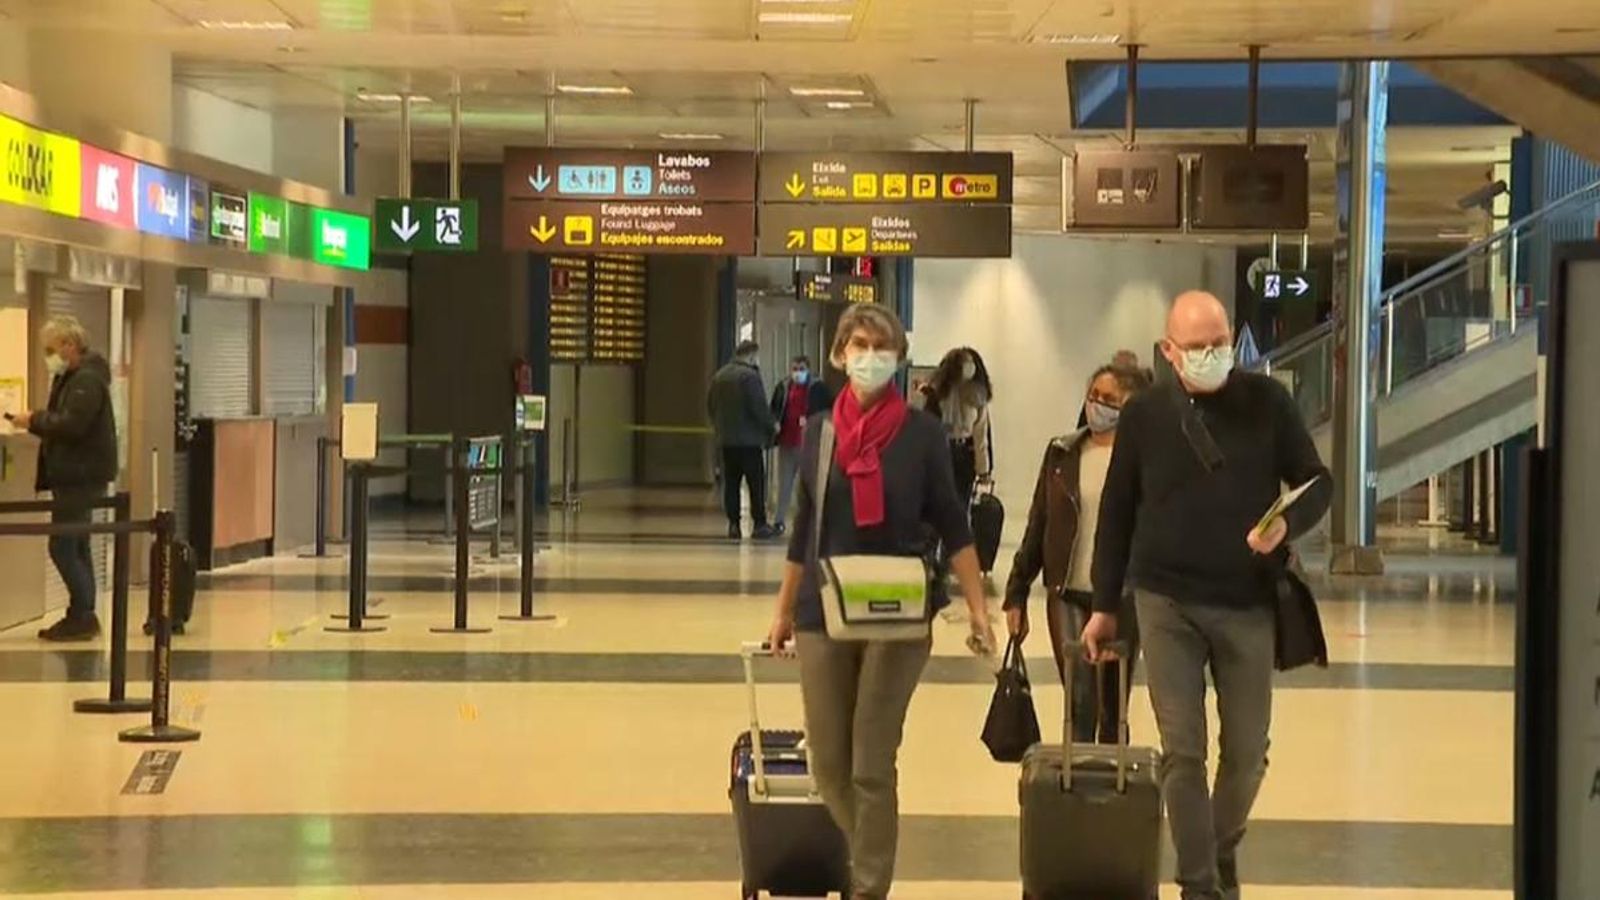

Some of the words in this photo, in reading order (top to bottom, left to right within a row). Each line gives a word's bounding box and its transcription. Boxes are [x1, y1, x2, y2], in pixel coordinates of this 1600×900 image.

[658, 154, 709, 167] Lavabos
[659, 168, 691, 181] Toilets
[658, 182, 695, 195] Aseos
[812, 187, 846, 198] Salida
[601, 204, 661, 217] Equipatges
[664, 204, 702, 216] trobats
[601, 217, 631, 230] Found
[635, 219, 676, 232] Luggage
[601, 231, 653, 246] Equipajes
[656, 233, 724, 246] encontrados
[871, 240, 910, 251] Salidas
